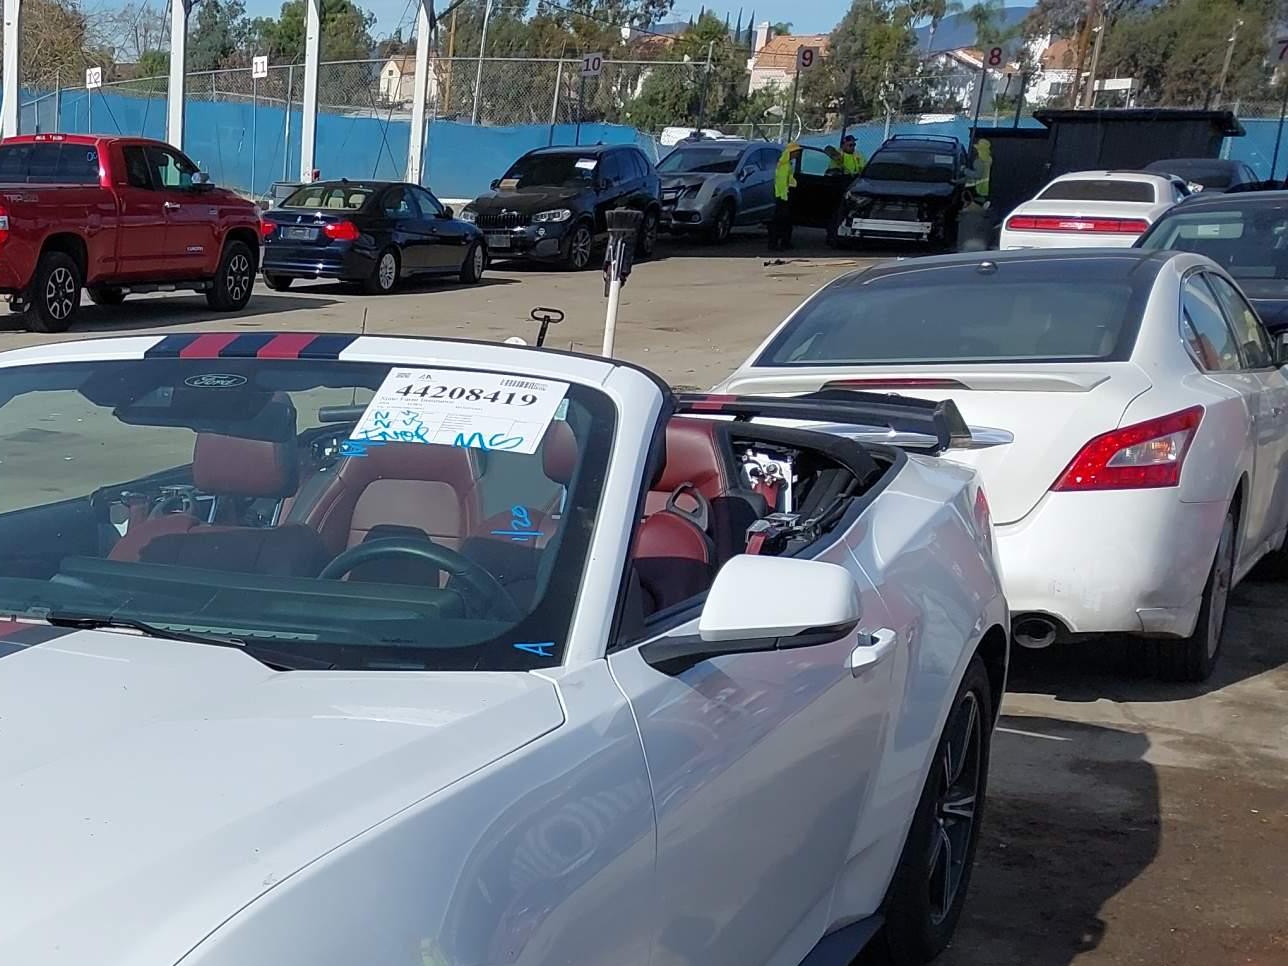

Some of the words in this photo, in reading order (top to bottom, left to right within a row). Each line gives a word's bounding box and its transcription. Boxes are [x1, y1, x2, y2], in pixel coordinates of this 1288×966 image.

[801, 49, 813, 67] 9
[989, 47, 1001, 66] 8
[1278, 40, 1288, 60] 7
[254, 61, 266, 74] 11
[583, 56, 601, 72] 10
[87, 71, 100, 85] 12
[395, 383, 538, 407] 44208419
[513, 642, 555, 657] A
